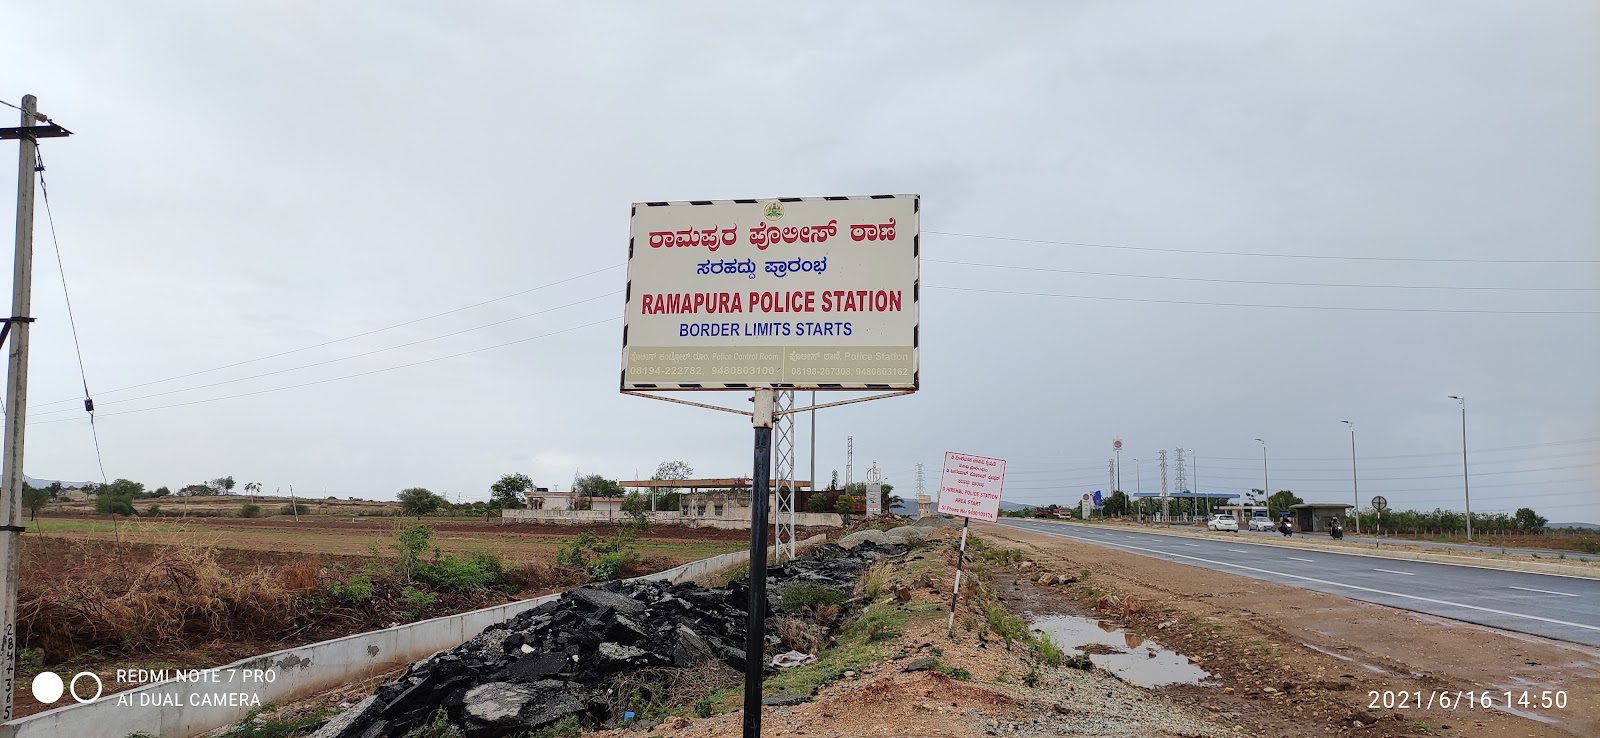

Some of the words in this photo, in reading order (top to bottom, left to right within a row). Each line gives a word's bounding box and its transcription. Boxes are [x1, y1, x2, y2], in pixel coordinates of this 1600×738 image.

[648, 222, 738, 252] ರಾಮಪುರ
[749, 220, 838, 250] ಪೊಲೀಸ್
[850, 217, 896, 242] ಠಾಣೆ
[696, 258, 756, 280] ಸರಹದ್ದು
[764, 256, 827, 278] ಪ್ರಾರಂಭ
[642, 292, 742, 315] RAMAPURA
[748, 290, 816, 313] POLICE
[821, 290, 902, 312] STATION
[679, 322, 740, 338] BORDER
[744, 322, 791, 336] LIMITS
[795, 322, 852, 336] STARTS
[712, 352, 732, 361] Police
[734, 352, 758, 361] Control
[759, 352, 779, 361] Room
[844, 352, 872, 361] Police
[875, 351, 908, 361] Station
[630, 366, 705, 376] 08194-222782,
[711, 366, 775, 375] 9480803100
[856, 367, 908, 376] 9480803162
